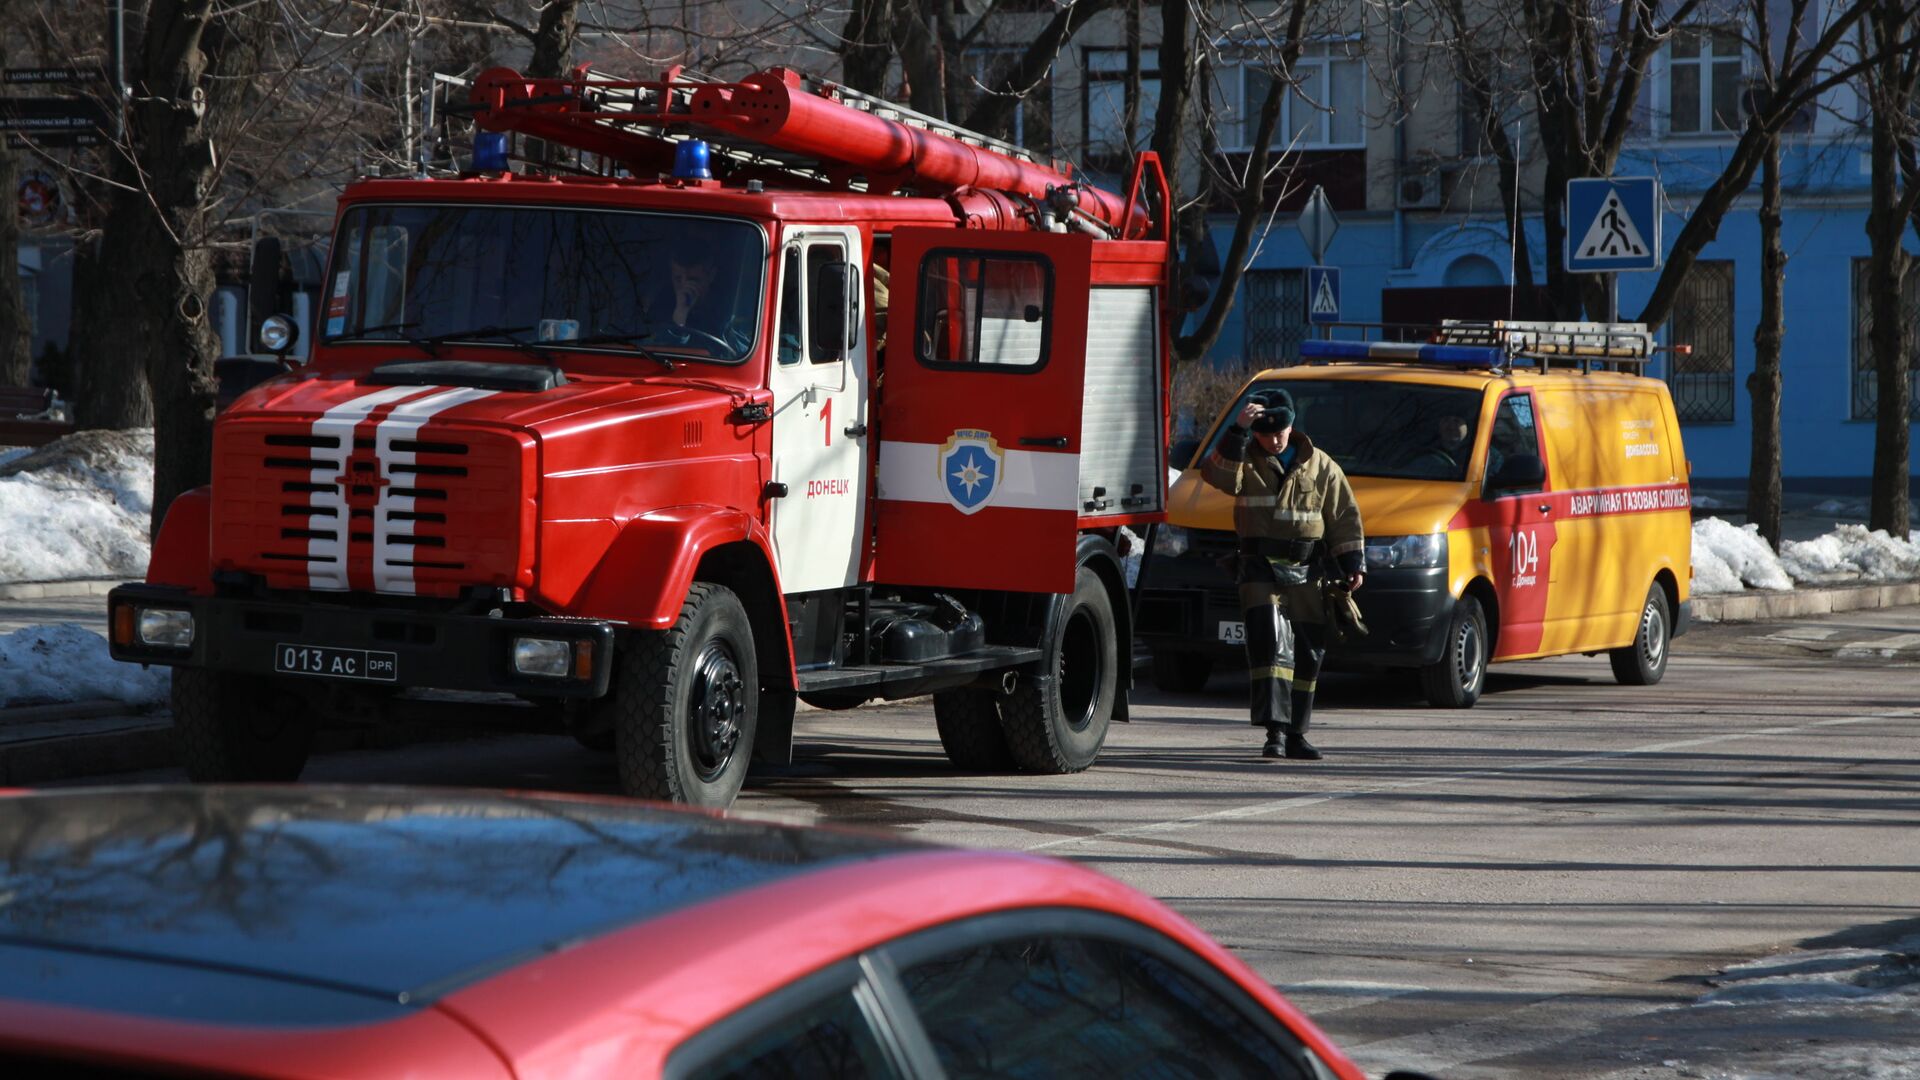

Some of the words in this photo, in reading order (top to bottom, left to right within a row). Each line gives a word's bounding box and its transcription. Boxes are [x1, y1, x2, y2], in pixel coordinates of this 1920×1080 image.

[820, 397, 832, 446] 1
[807, 480, 849, 498] ДОНЕЦК
[1570, 492, 1622, 515] АВАРИЙНАЯ
[1622, 492, 1659, 511] ГАЗОВАЯ
[1659, 488, 1689, 508] СЛУЖБА
[1508, 530, 1538, 574] 104
[284, 648, 322, 671] 013
[369, 660, 392, 671] DPR
